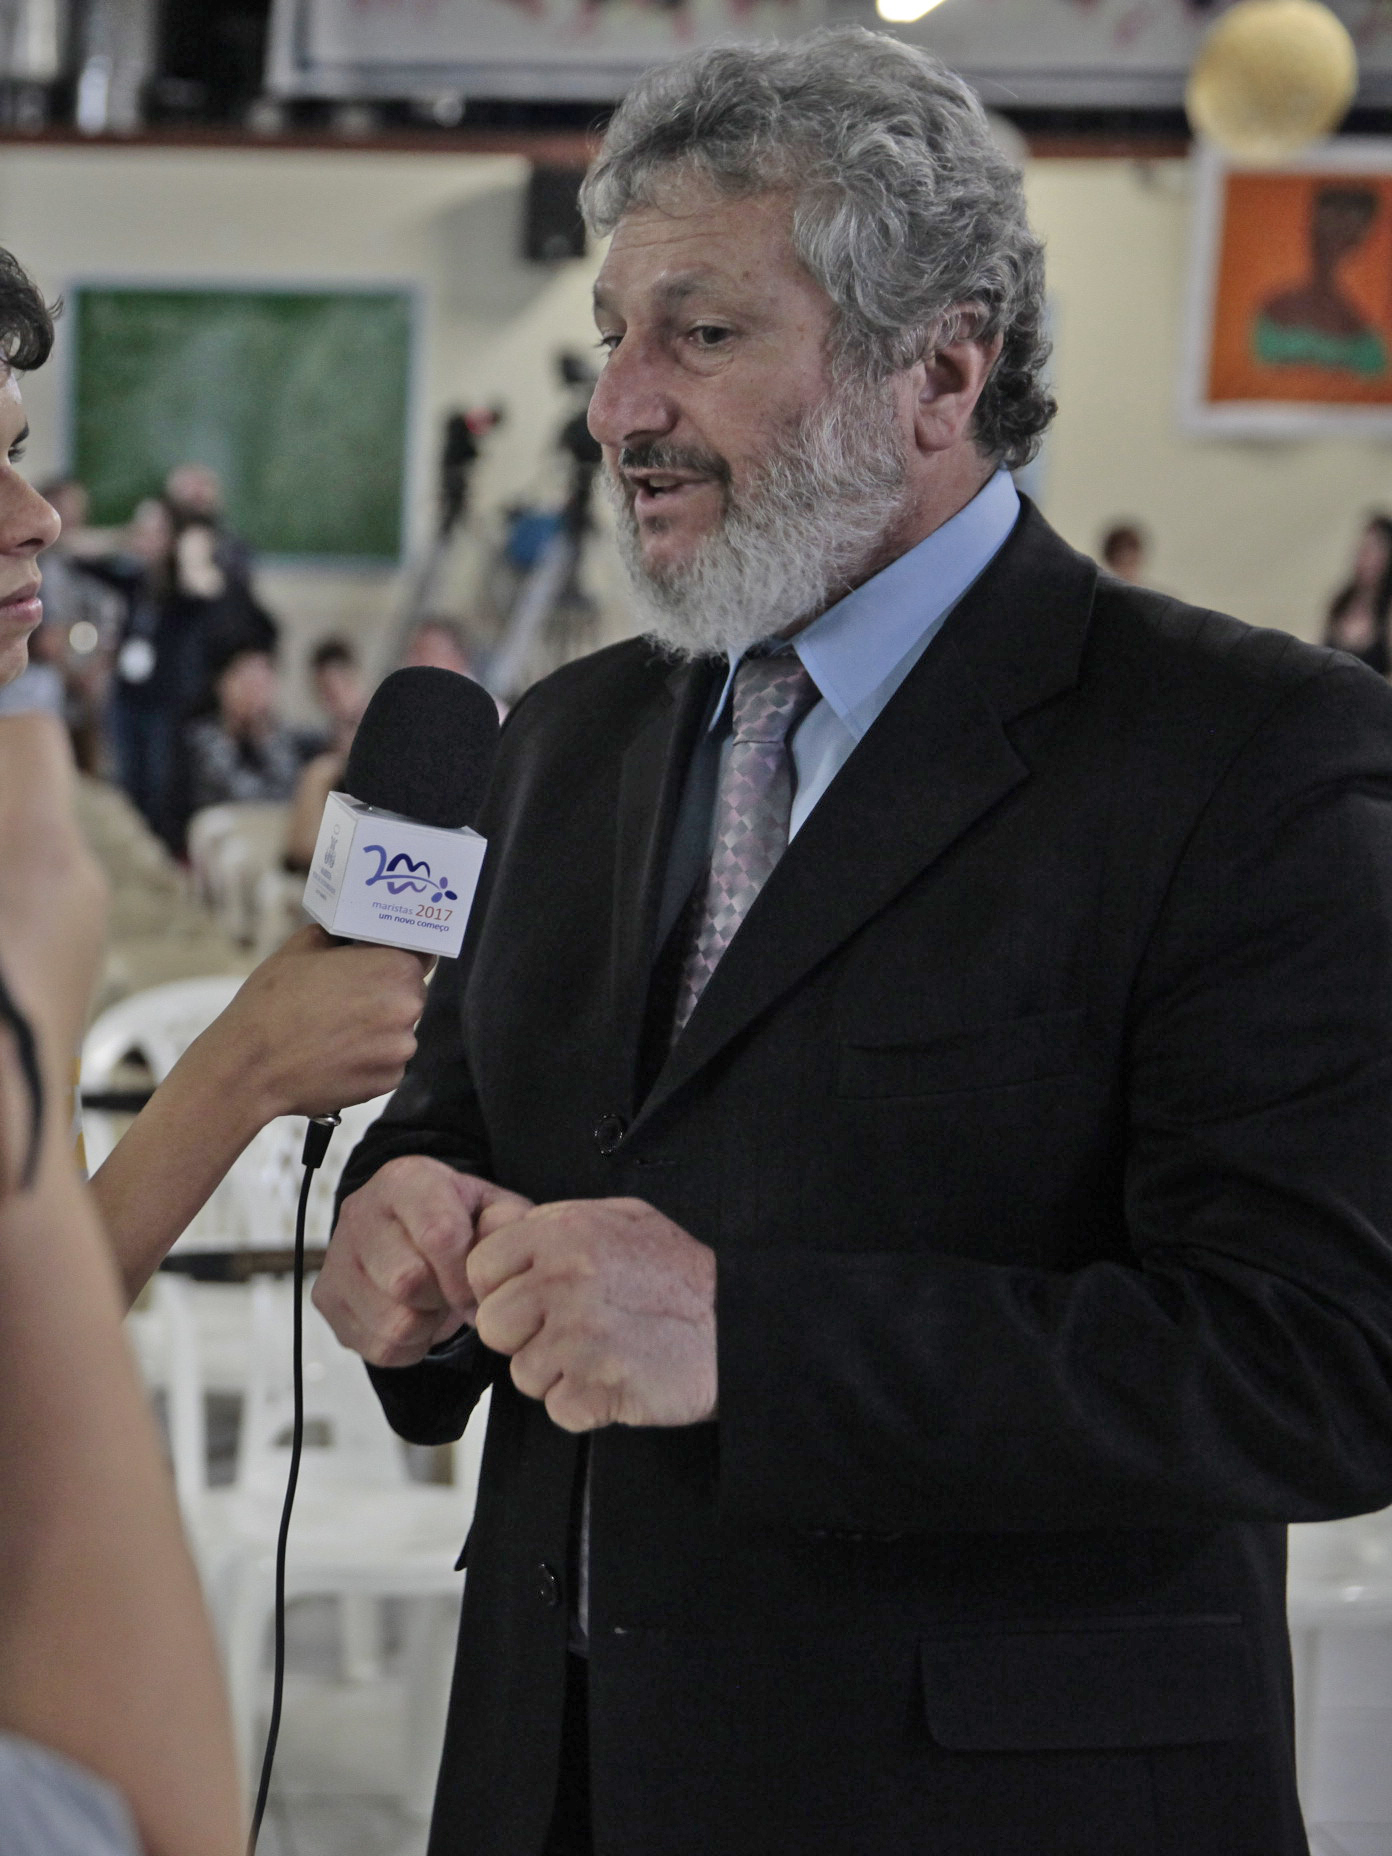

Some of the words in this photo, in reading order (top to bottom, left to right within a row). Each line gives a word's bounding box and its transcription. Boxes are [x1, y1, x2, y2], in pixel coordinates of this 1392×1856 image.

[372, 902, 413, 915] maristas
[416, 905, 452, 922] 2017
[378, 913, 392, 921] um
[394, 916, 415, 925] novo
[417, 919, 449, 932] começo
